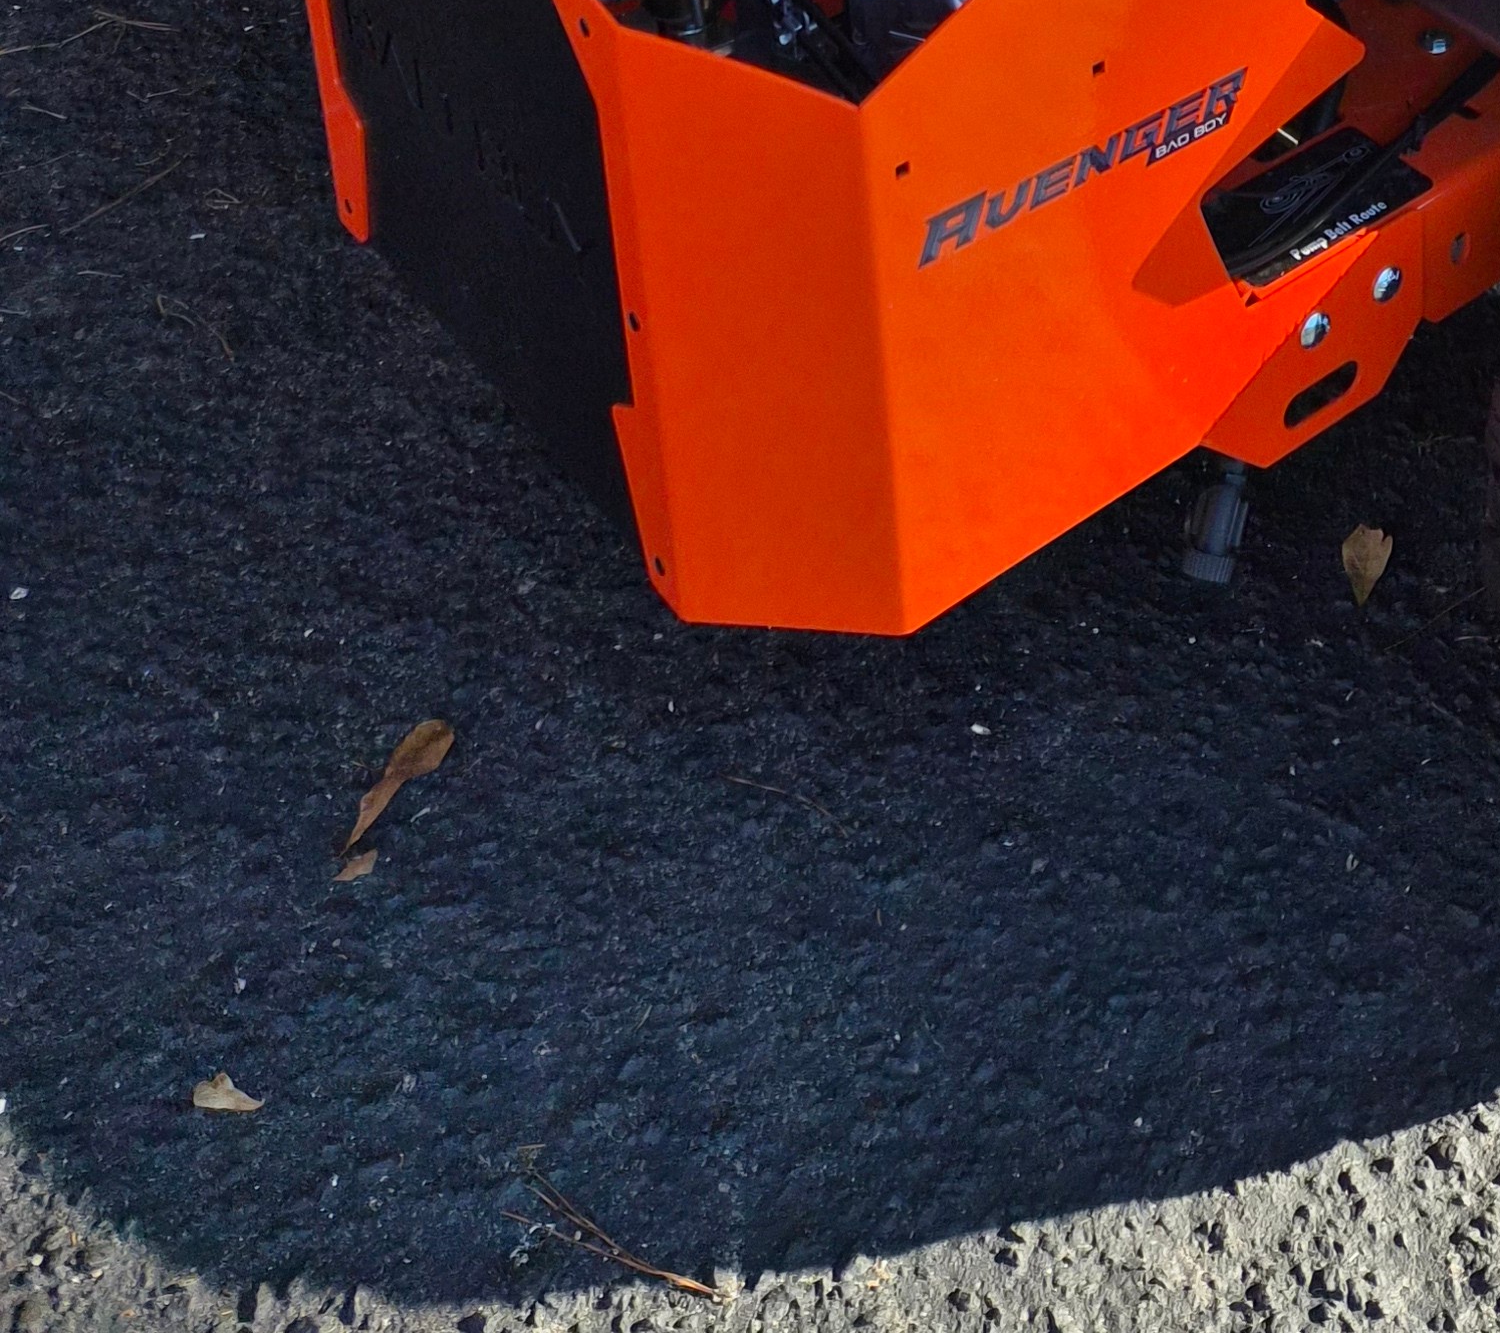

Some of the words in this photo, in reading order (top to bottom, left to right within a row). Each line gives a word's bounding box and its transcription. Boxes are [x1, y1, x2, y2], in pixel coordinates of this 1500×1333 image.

[1154, 134, 1190, 160] BAD
[1193, 112, 1228, 139] BOY
[918, 65, 1249, 270] AVENGER
[1323, 221, 1352, 241] Belt
[1348, 201, 1388, 225] Route
